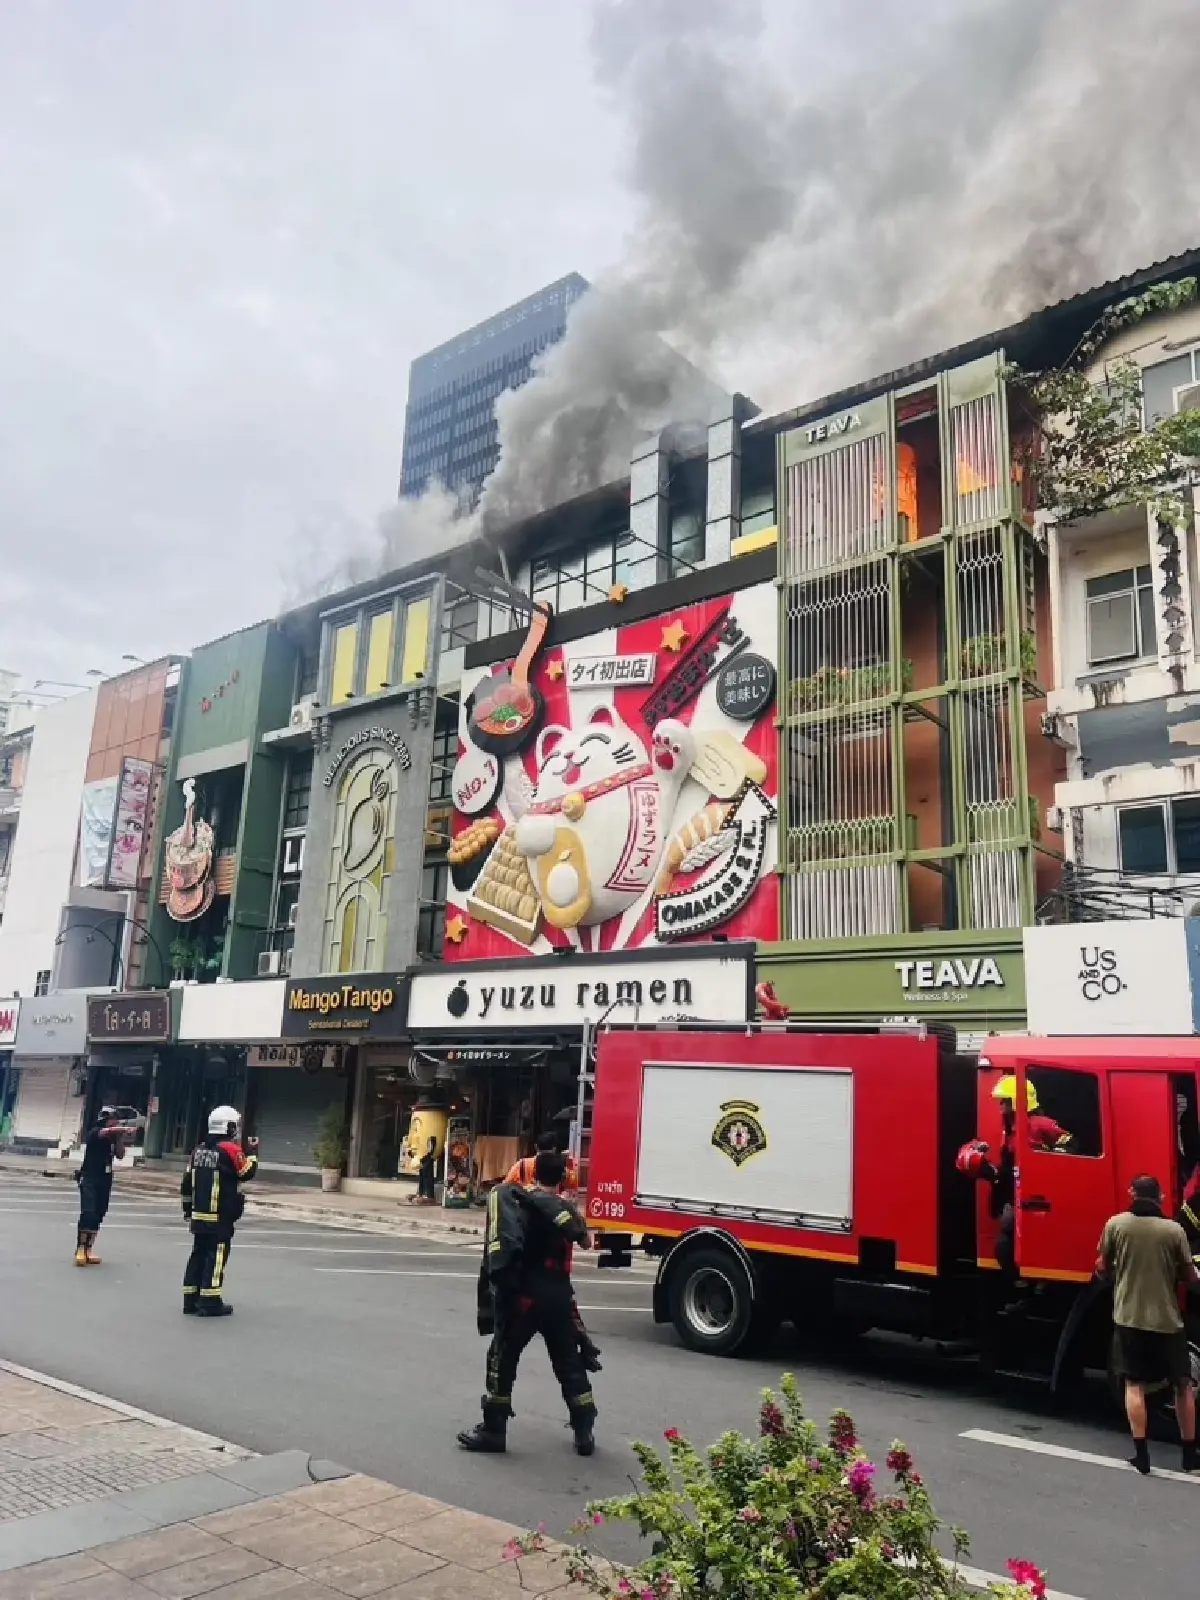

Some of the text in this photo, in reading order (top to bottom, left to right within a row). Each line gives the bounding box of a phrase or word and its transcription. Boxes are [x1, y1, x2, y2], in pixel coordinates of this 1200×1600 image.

[805, 414, 862, 444] TEAVA
[572, 658, 648, 682] タイ初出店
[661, 871, 743, 925] OMAKASE
[1079, 946, 1118, 971] US
[894, 958, 1005, 989] TEAVA
[1078, 968, 1101, 980] AND
[1082, 973, 1128, 1001] CO.
[288, 985, 394, 1014] Mango Tango
[477, 978, 693, 1019] yuzu ramen
[951, 991, 968, 1002] Spa
[604, 1202, 625, 1217] 199
